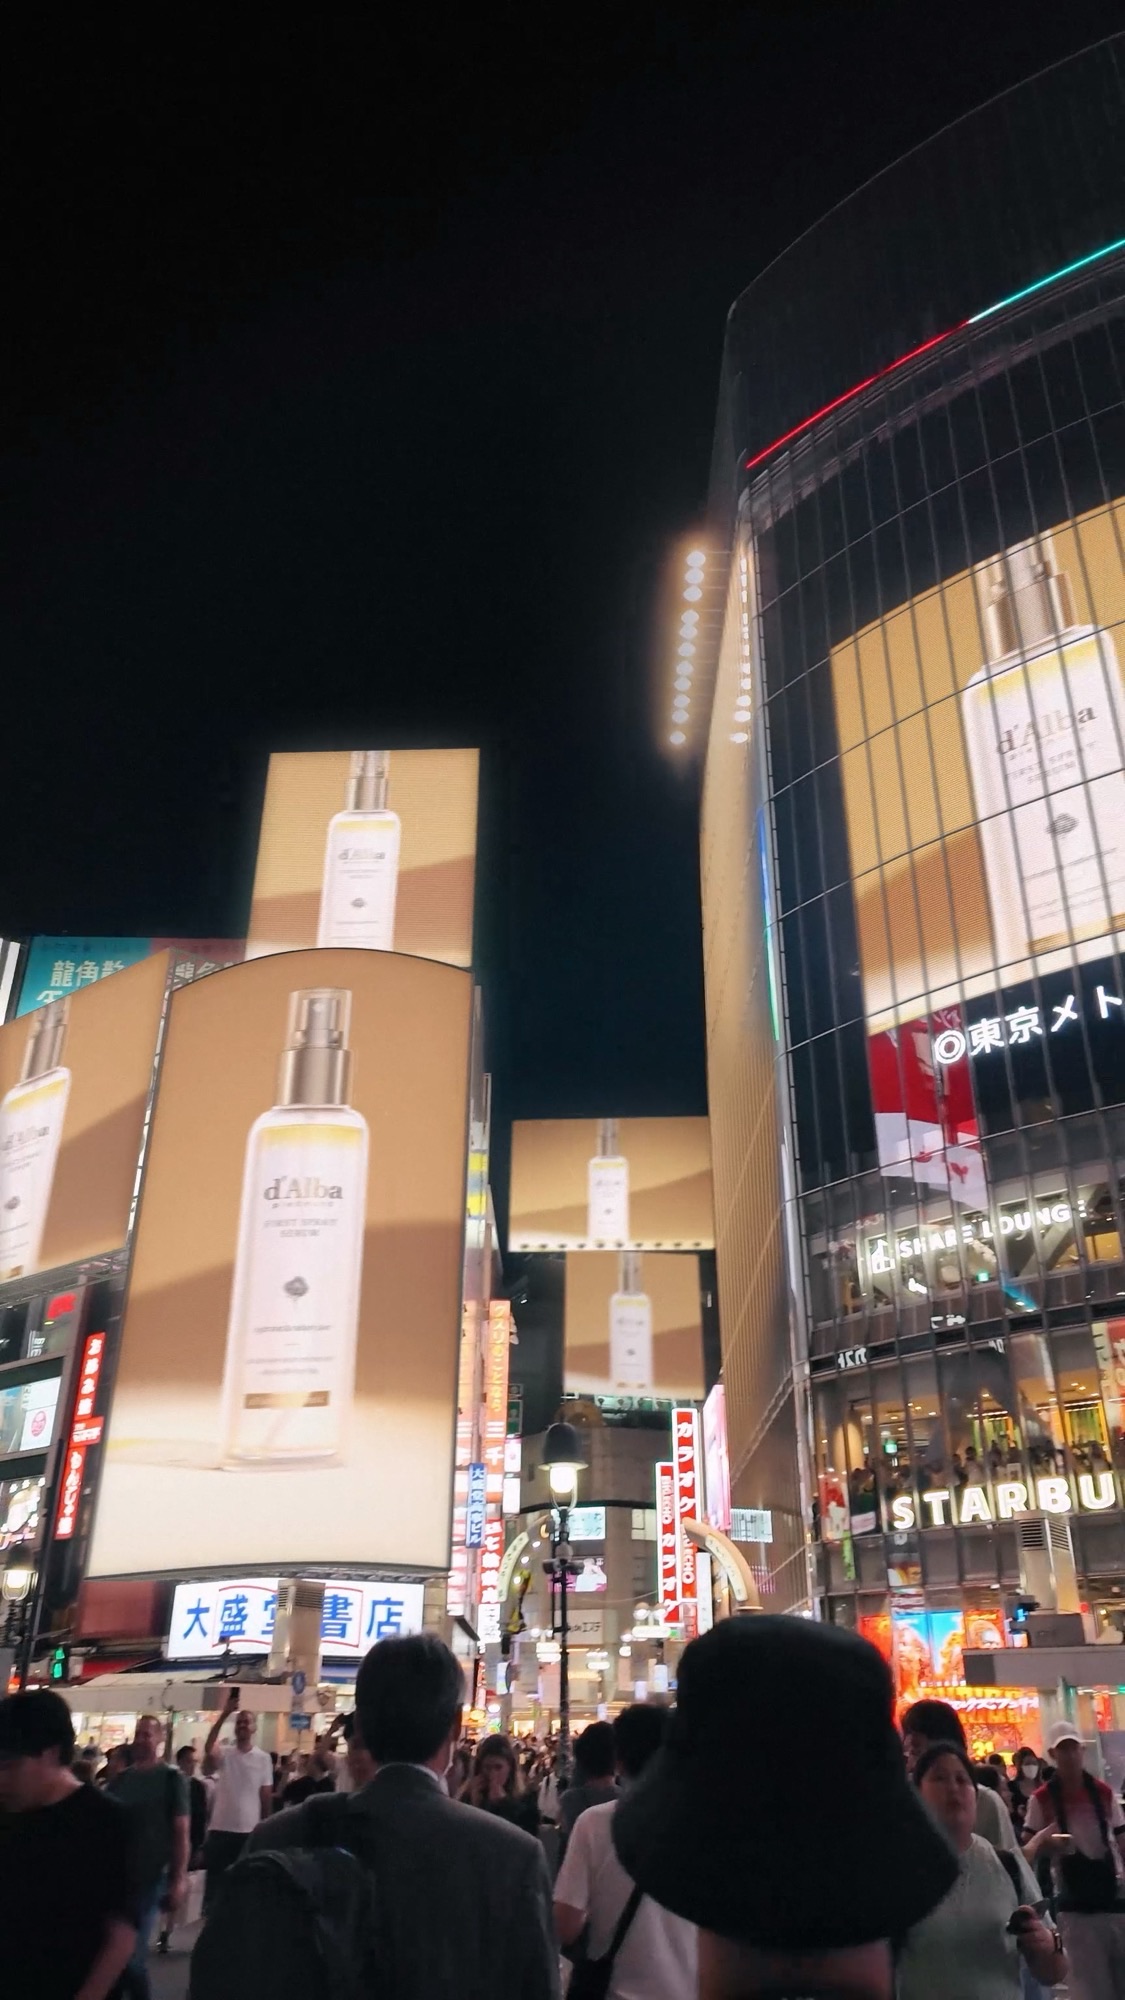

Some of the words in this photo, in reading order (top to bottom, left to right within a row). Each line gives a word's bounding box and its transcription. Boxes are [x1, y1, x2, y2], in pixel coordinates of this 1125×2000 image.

[967, 985, 1123, 1057] 東京メト
[263, 1175, 344, 1201] d'Alba
[899, 1224, 974, 1259] SHARE
[676, 1420, 697, 1514] カラオケ
[891, 1471, 1117, 1530] STARBU
[661, 1531, 683, 1618] カラオケ
